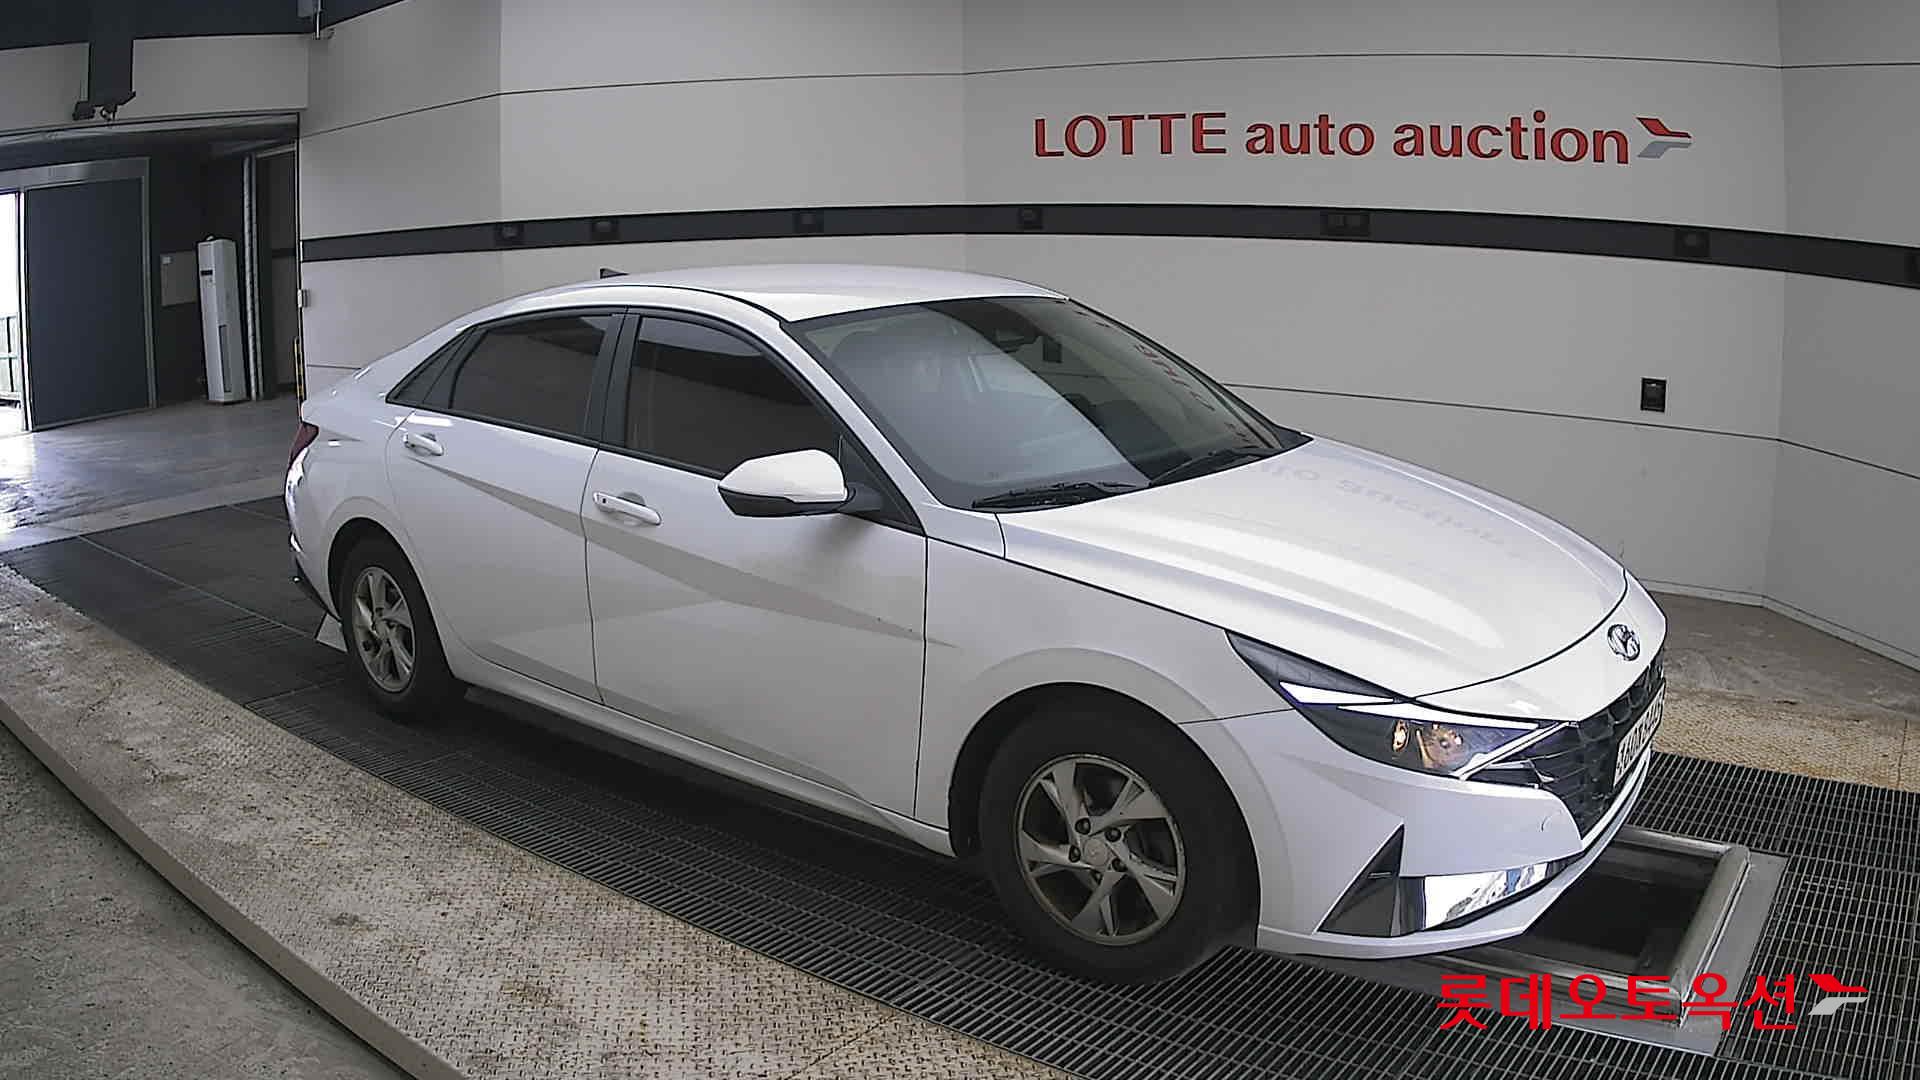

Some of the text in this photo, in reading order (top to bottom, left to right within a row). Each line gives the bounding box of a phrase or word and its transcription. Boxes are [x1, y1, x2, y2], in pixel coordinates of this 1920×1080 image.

[1034, 110, 1630, 165] LOTTE auto auction
